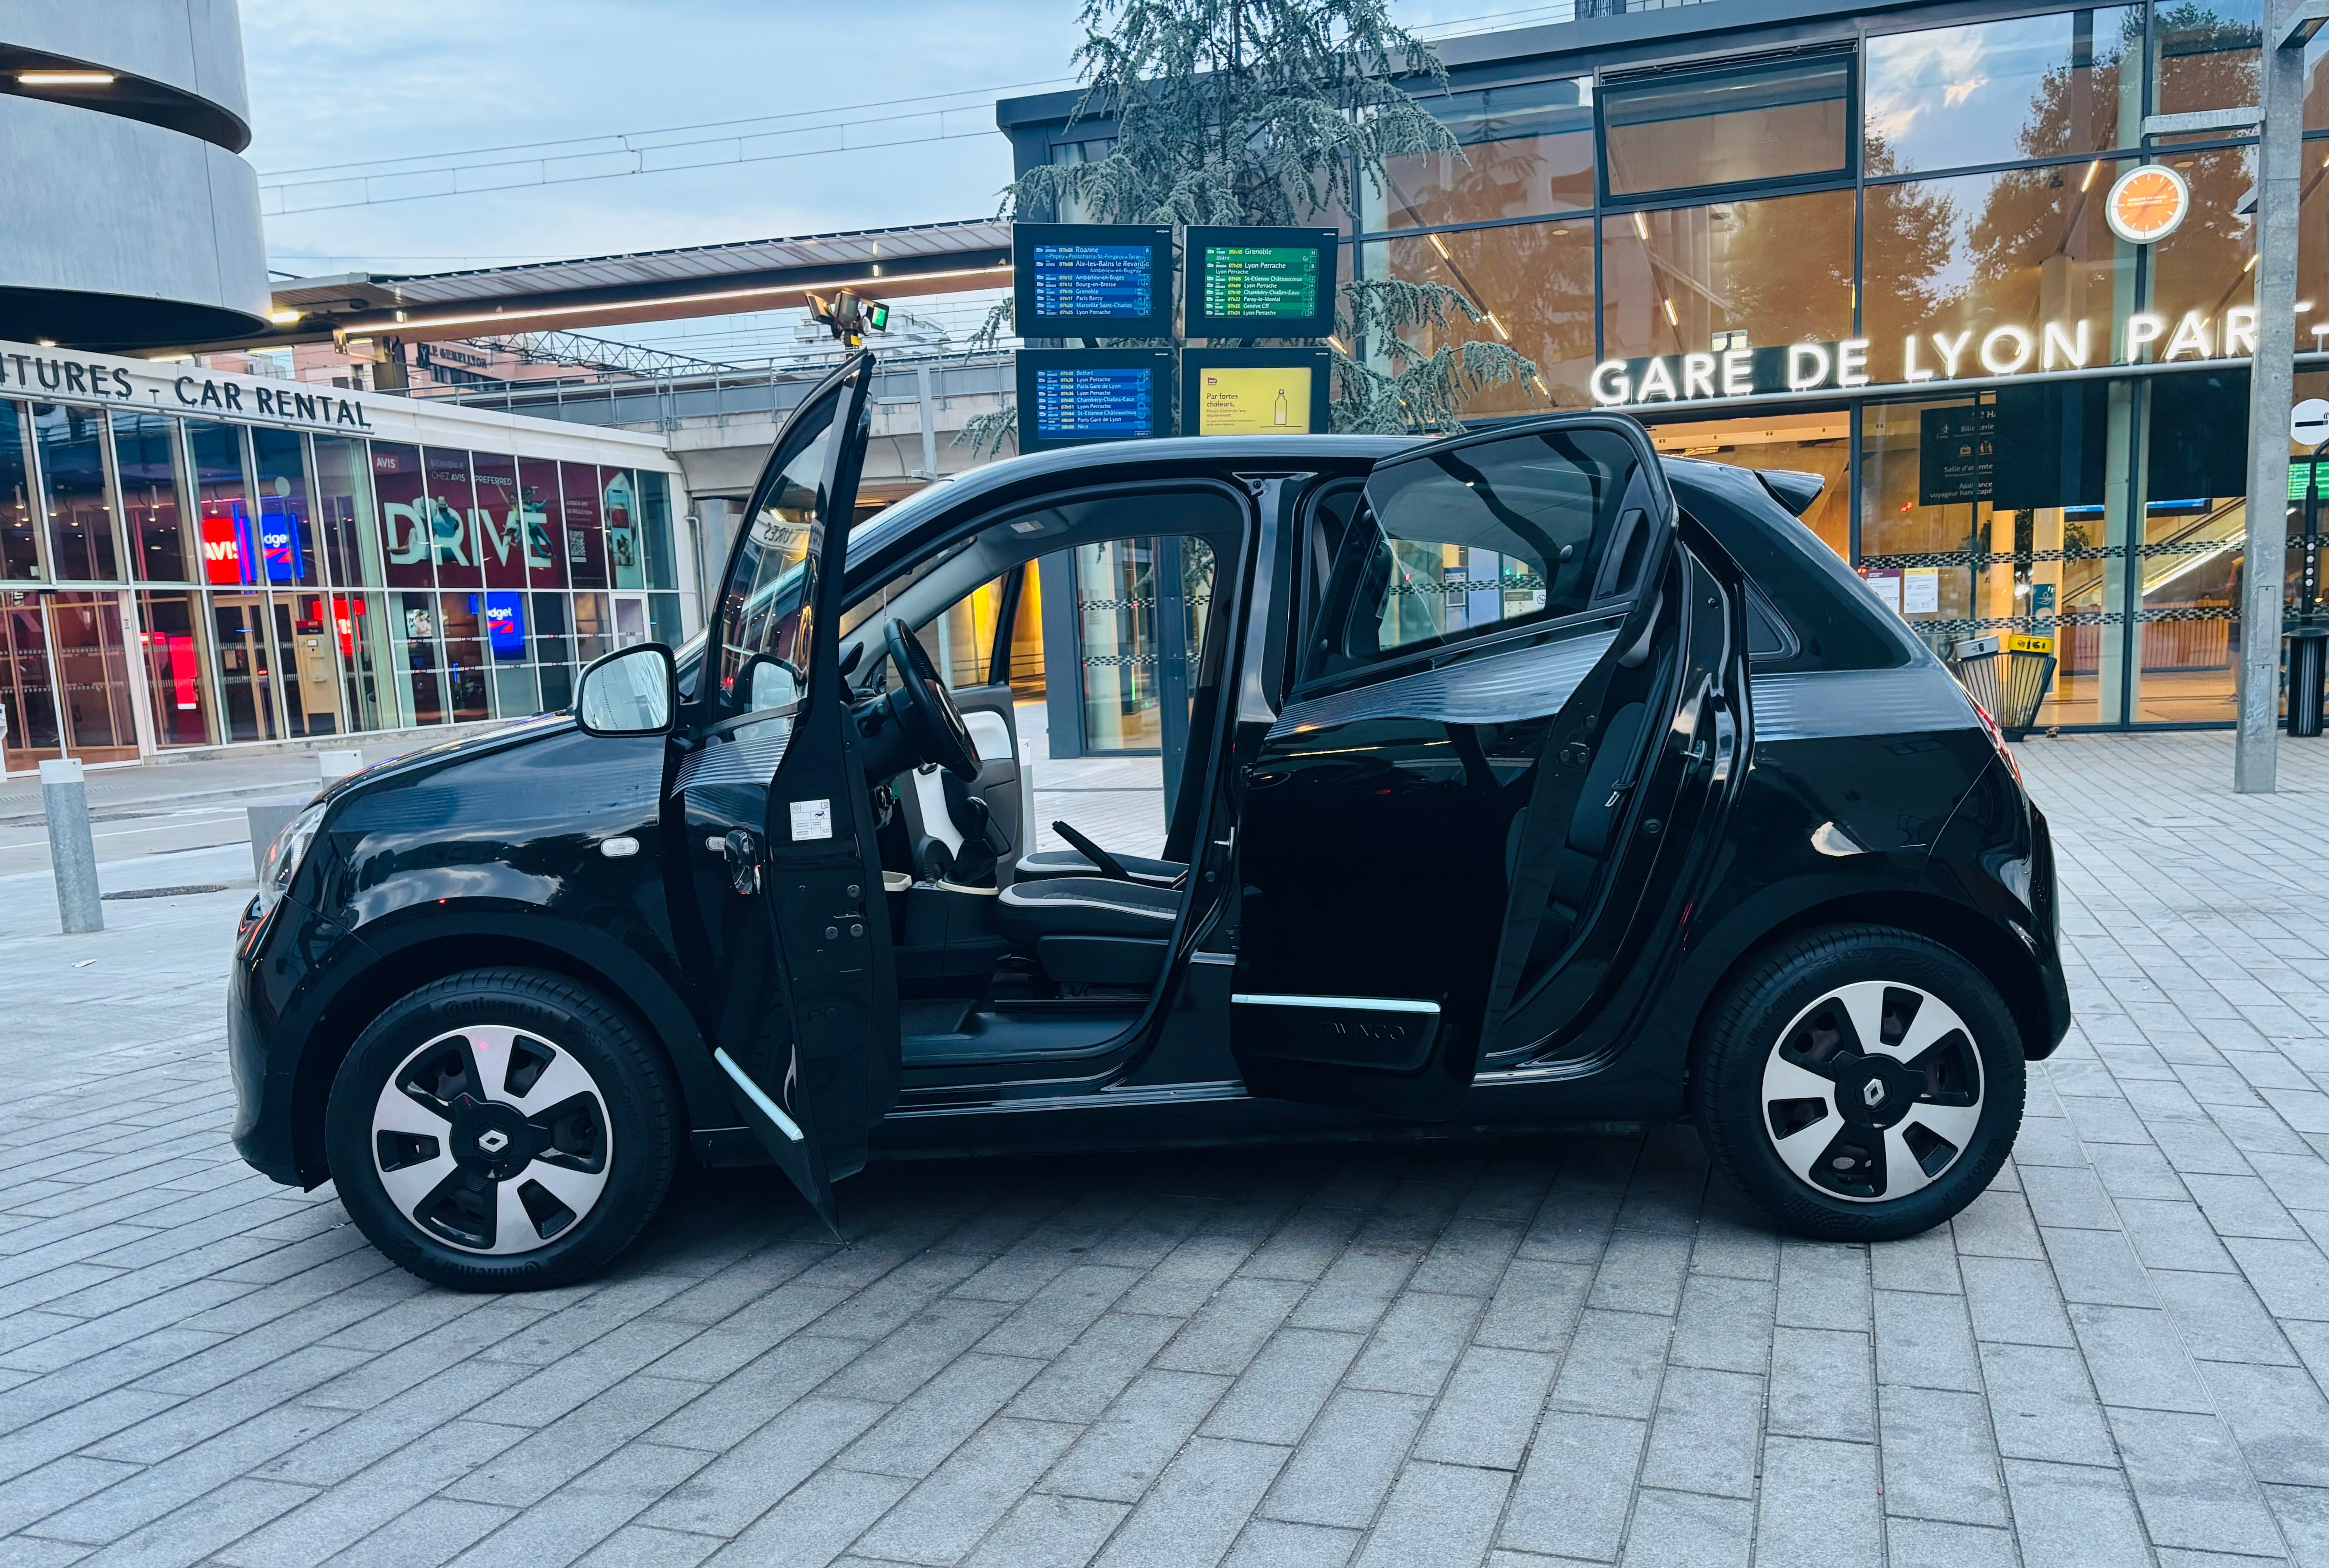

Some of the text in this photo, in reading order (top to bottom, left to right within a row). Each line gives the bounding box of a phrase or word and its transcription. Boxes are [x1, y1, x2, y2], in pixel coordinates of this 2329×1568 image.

[1591, 349, 1753, 405] GARE
[1789, 339, 1869, 389] DE
[1905, 319, 2087, 380] LYON
[175, 376, 243, 410] CAR
[256, 387, 372, 427] RENTAL
[376, 457, 396, 468] AVIS
[431, 459, 464, 469] BIENVENUE
[432, 471, 512, 486] CHEZ AVIS PREFERRED
[264, 533, 287, 547] dge
[383, 502, 551, 567] DRIVE
[487, 607, 513, 621] dget
